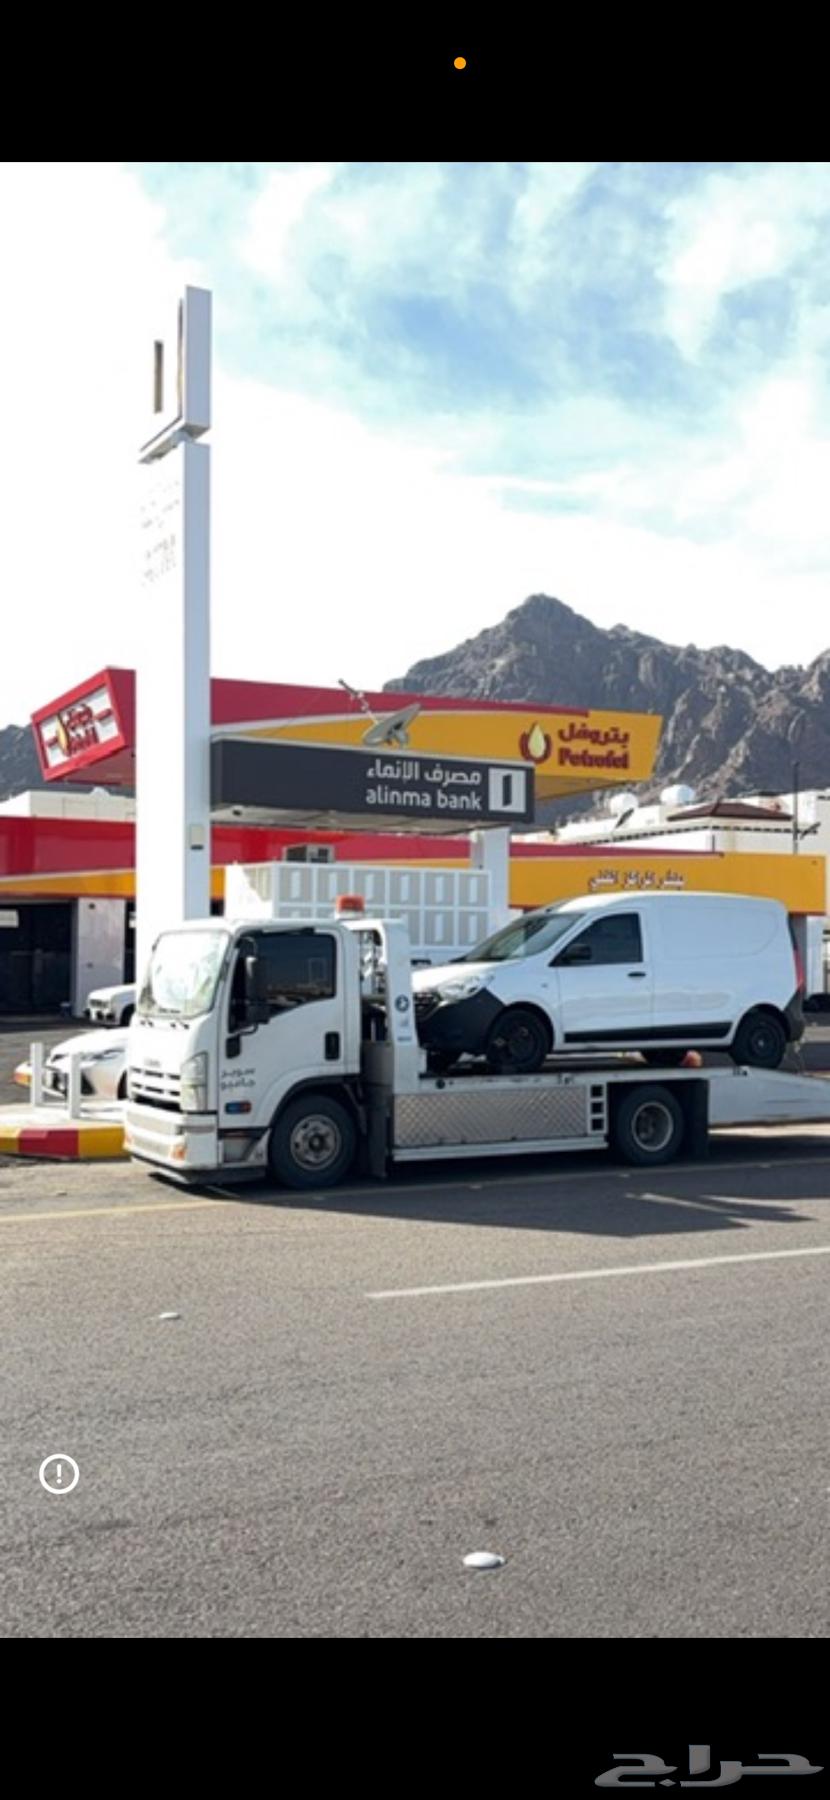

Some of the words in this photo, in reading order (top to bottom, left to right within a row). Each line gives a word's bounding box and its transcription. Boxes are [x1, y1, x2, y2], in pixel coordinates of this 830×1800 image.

[558, 722, 629, 748] بتروفل
[366, 759, 420, 783] الإنماء
[424, 763, 482, 787] مصرف
[366, 785, 432, 807] alinma
[437, 789, 482, 811] bank
